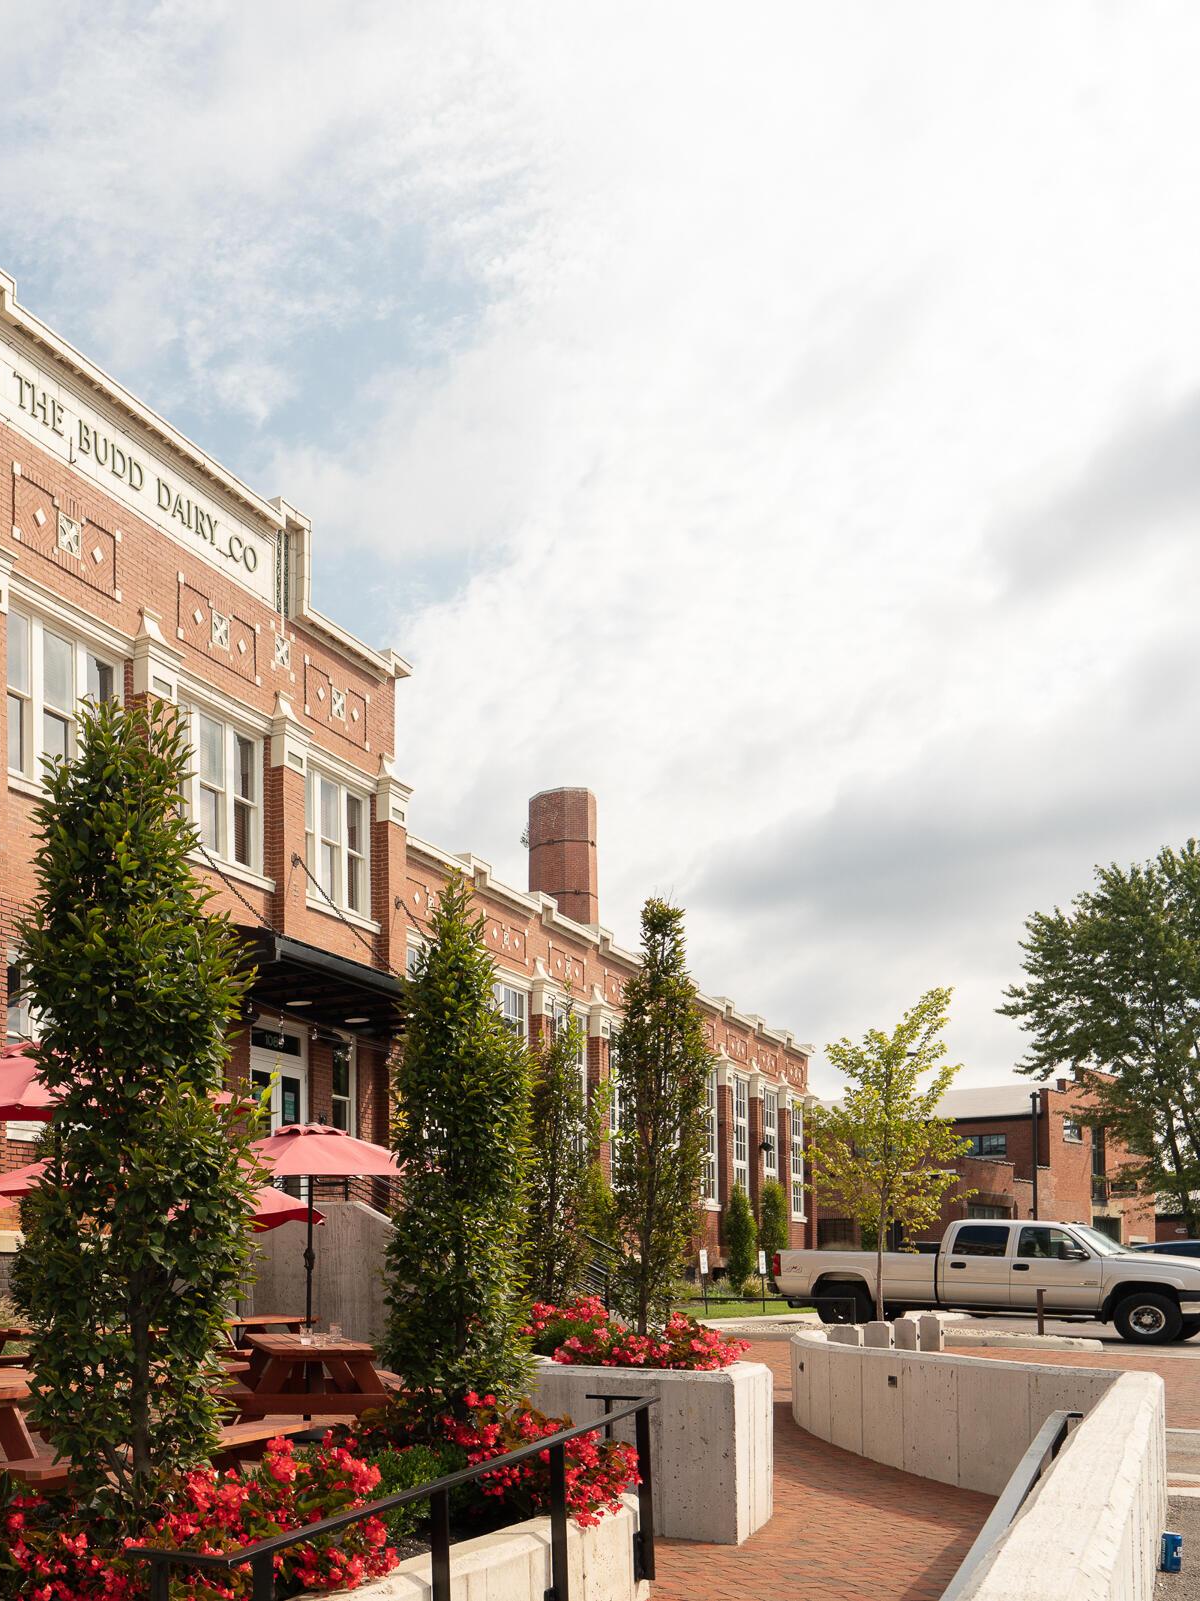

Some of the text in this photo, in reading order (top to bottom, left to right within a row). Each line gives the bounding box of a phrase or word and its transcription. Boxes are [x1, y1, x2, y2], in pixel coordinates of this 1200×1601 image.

[13, 371, 259, 573] THE BUDD DAIRY CO
